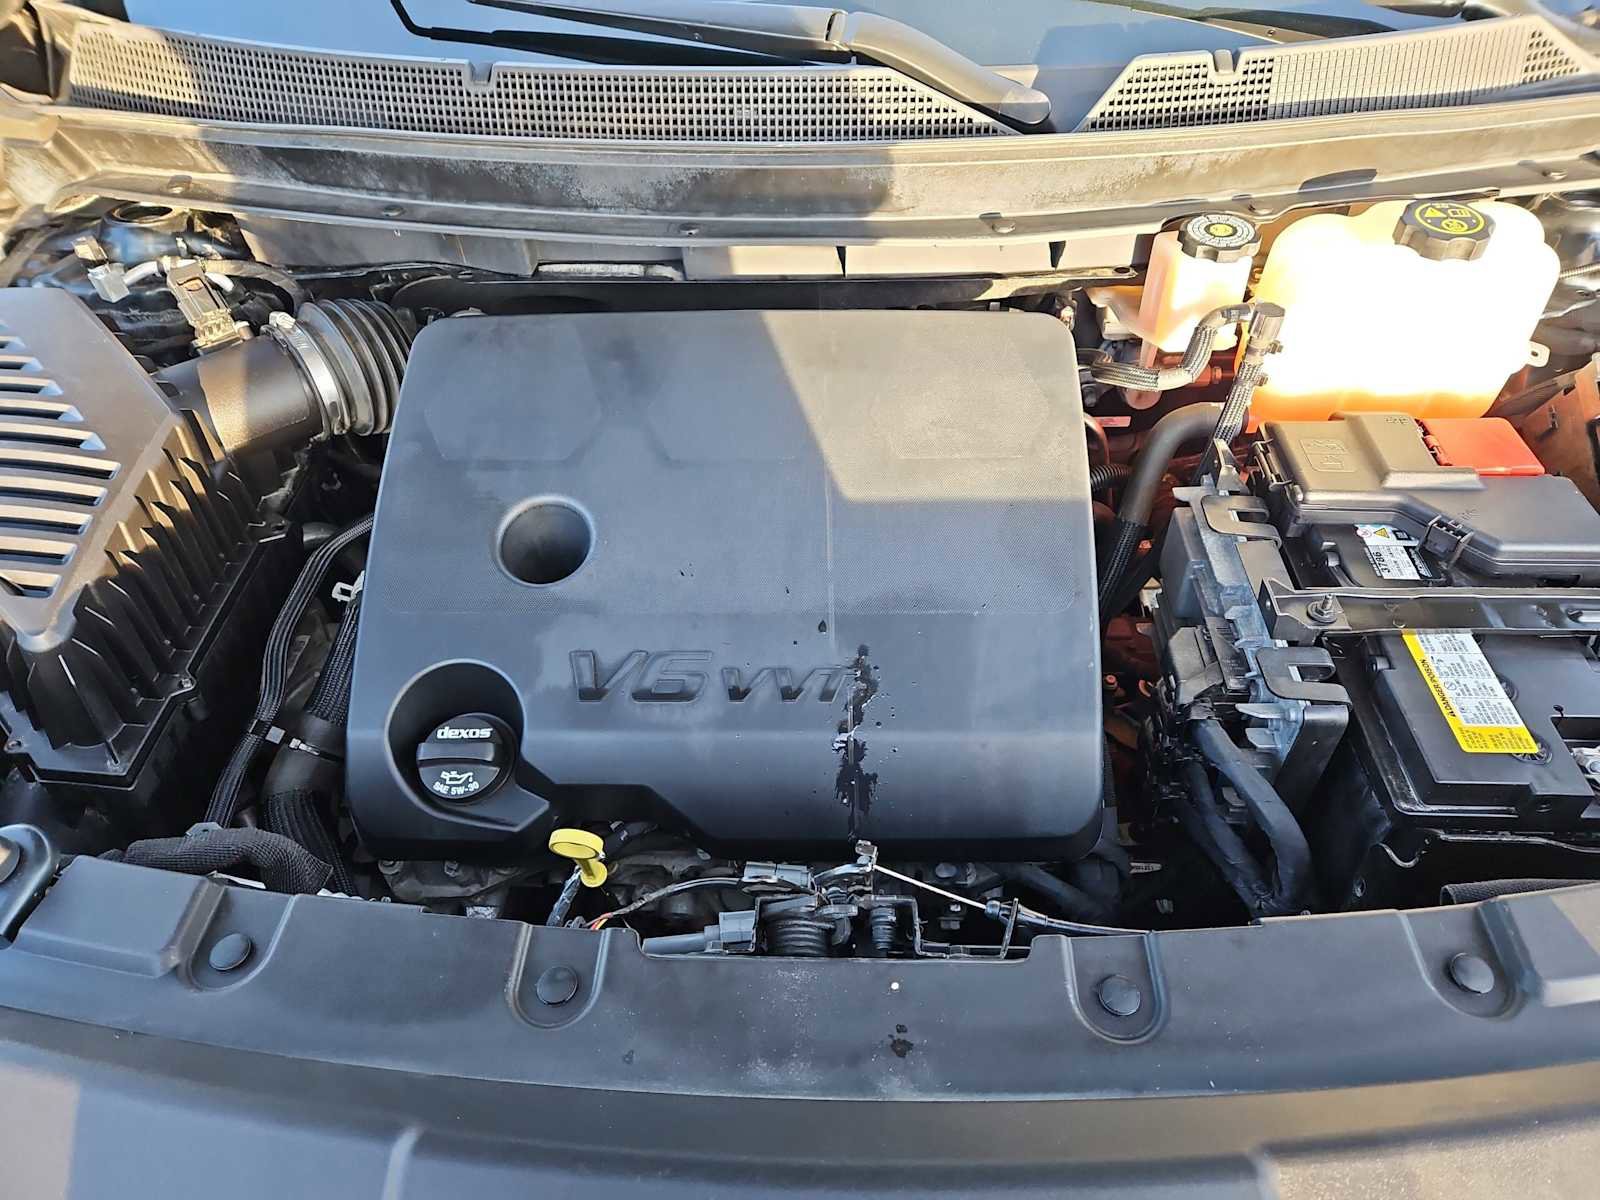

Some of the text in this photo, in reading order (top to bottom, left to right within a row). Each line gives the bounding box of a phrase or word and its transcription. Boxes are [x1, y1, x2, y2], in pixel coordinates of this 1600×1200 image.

[569, 650, 712, 703] V6
[436, 726, 494, 739] dexos
[432, 781, 480, 796] SAE 5W-30
